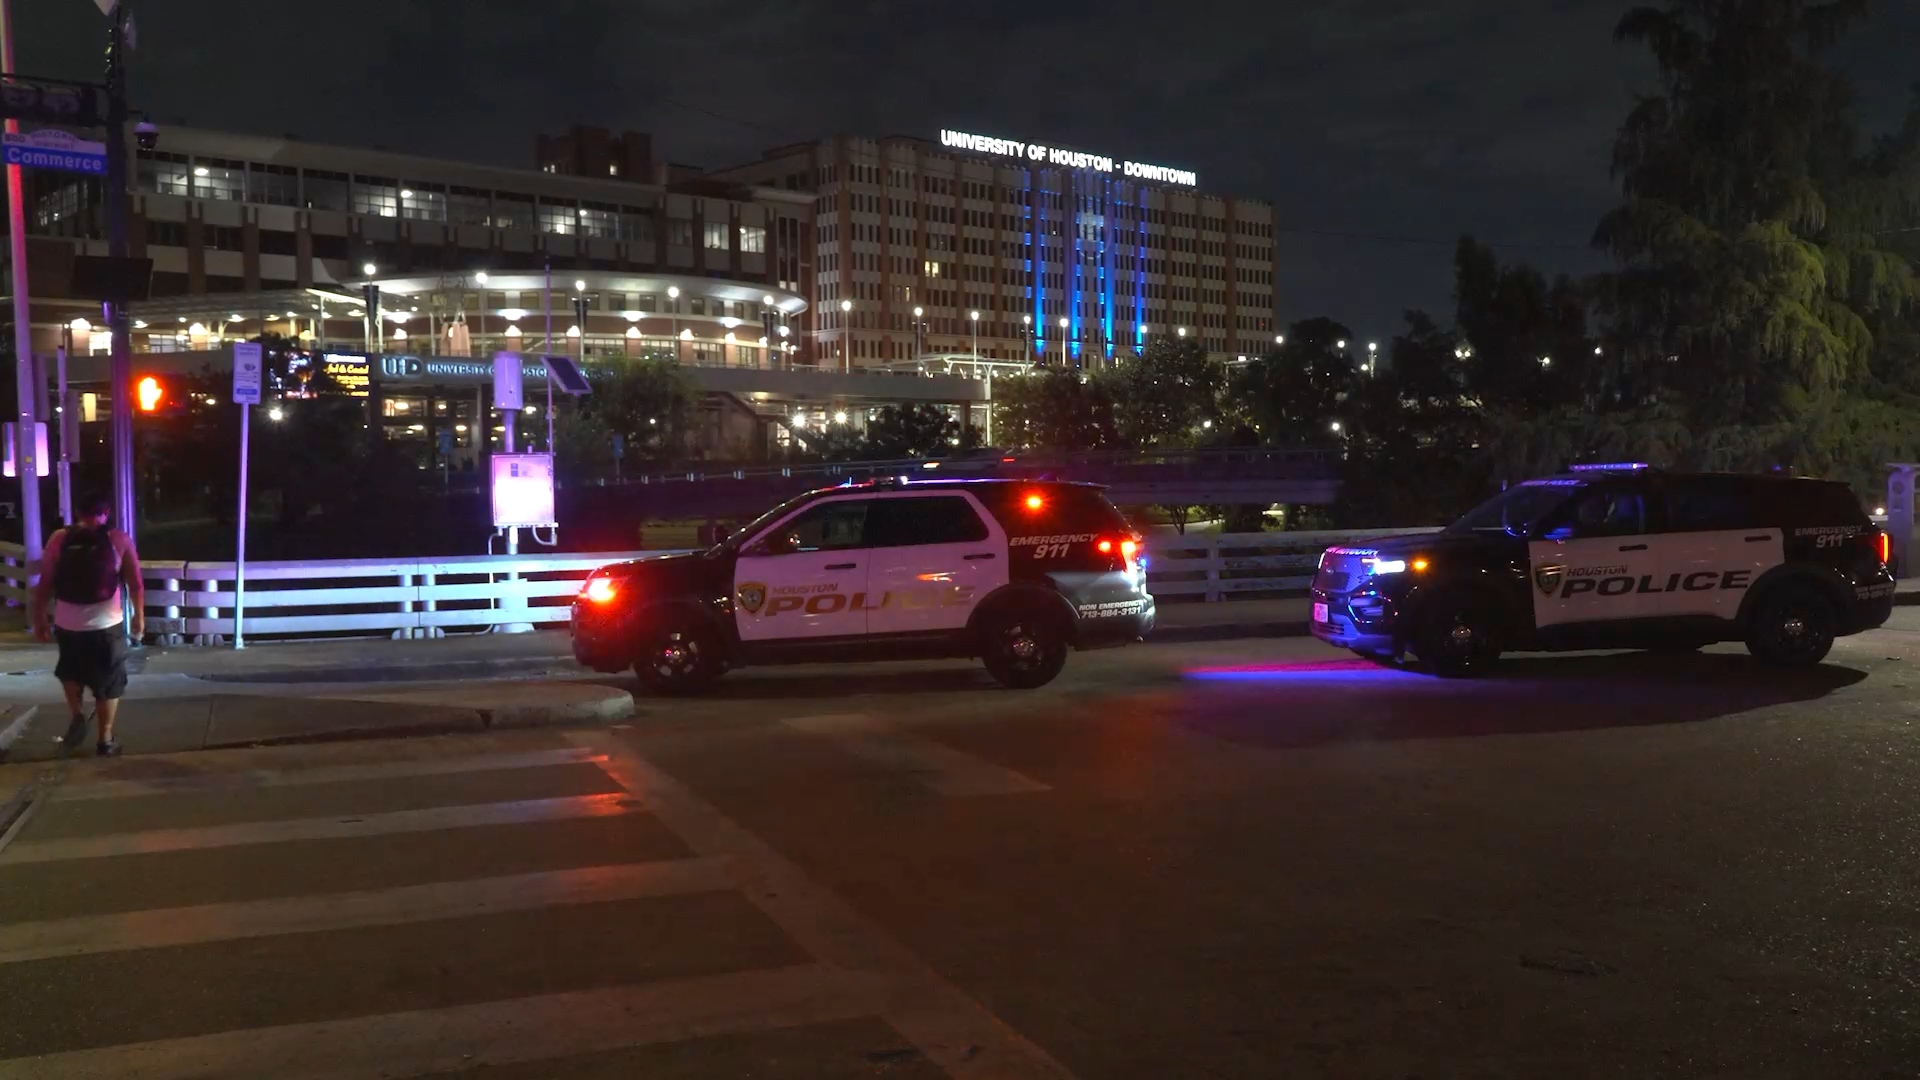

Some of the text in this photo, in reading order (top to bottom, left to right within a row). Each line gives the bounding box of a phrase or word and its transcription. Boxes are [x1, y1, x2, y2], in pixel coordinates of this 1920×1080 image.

[7, 147, 103, 171] Commerce
[940, 129, 1025, 158] UNIVERSITY
[1027, 143, 1047, 161] OF
[1049, 147, 1113, 173] HOUSTON
[1124, 160, 1196, 187] DOWNTOWN
[427, 363, 486, 375] UNIVERSITY
[1794, 525, 1863, 537] EMERGENCY
[1009, 533, 1099, 547] EMERGENCY
[1815, 534, 1844, 549] 911
[1033, 543, 1070, 560] 911
[1566, 564, 1629, 577] HOUSTON
[771, 583, 839, 595] HOUSTON
[1559, 570, 1752, 599] POLICE
[764, 585, 976, 617] POLICE
[1079, 603, 1098, 611] NON
[1081, 606, 1142, 619] 713-884-3131
